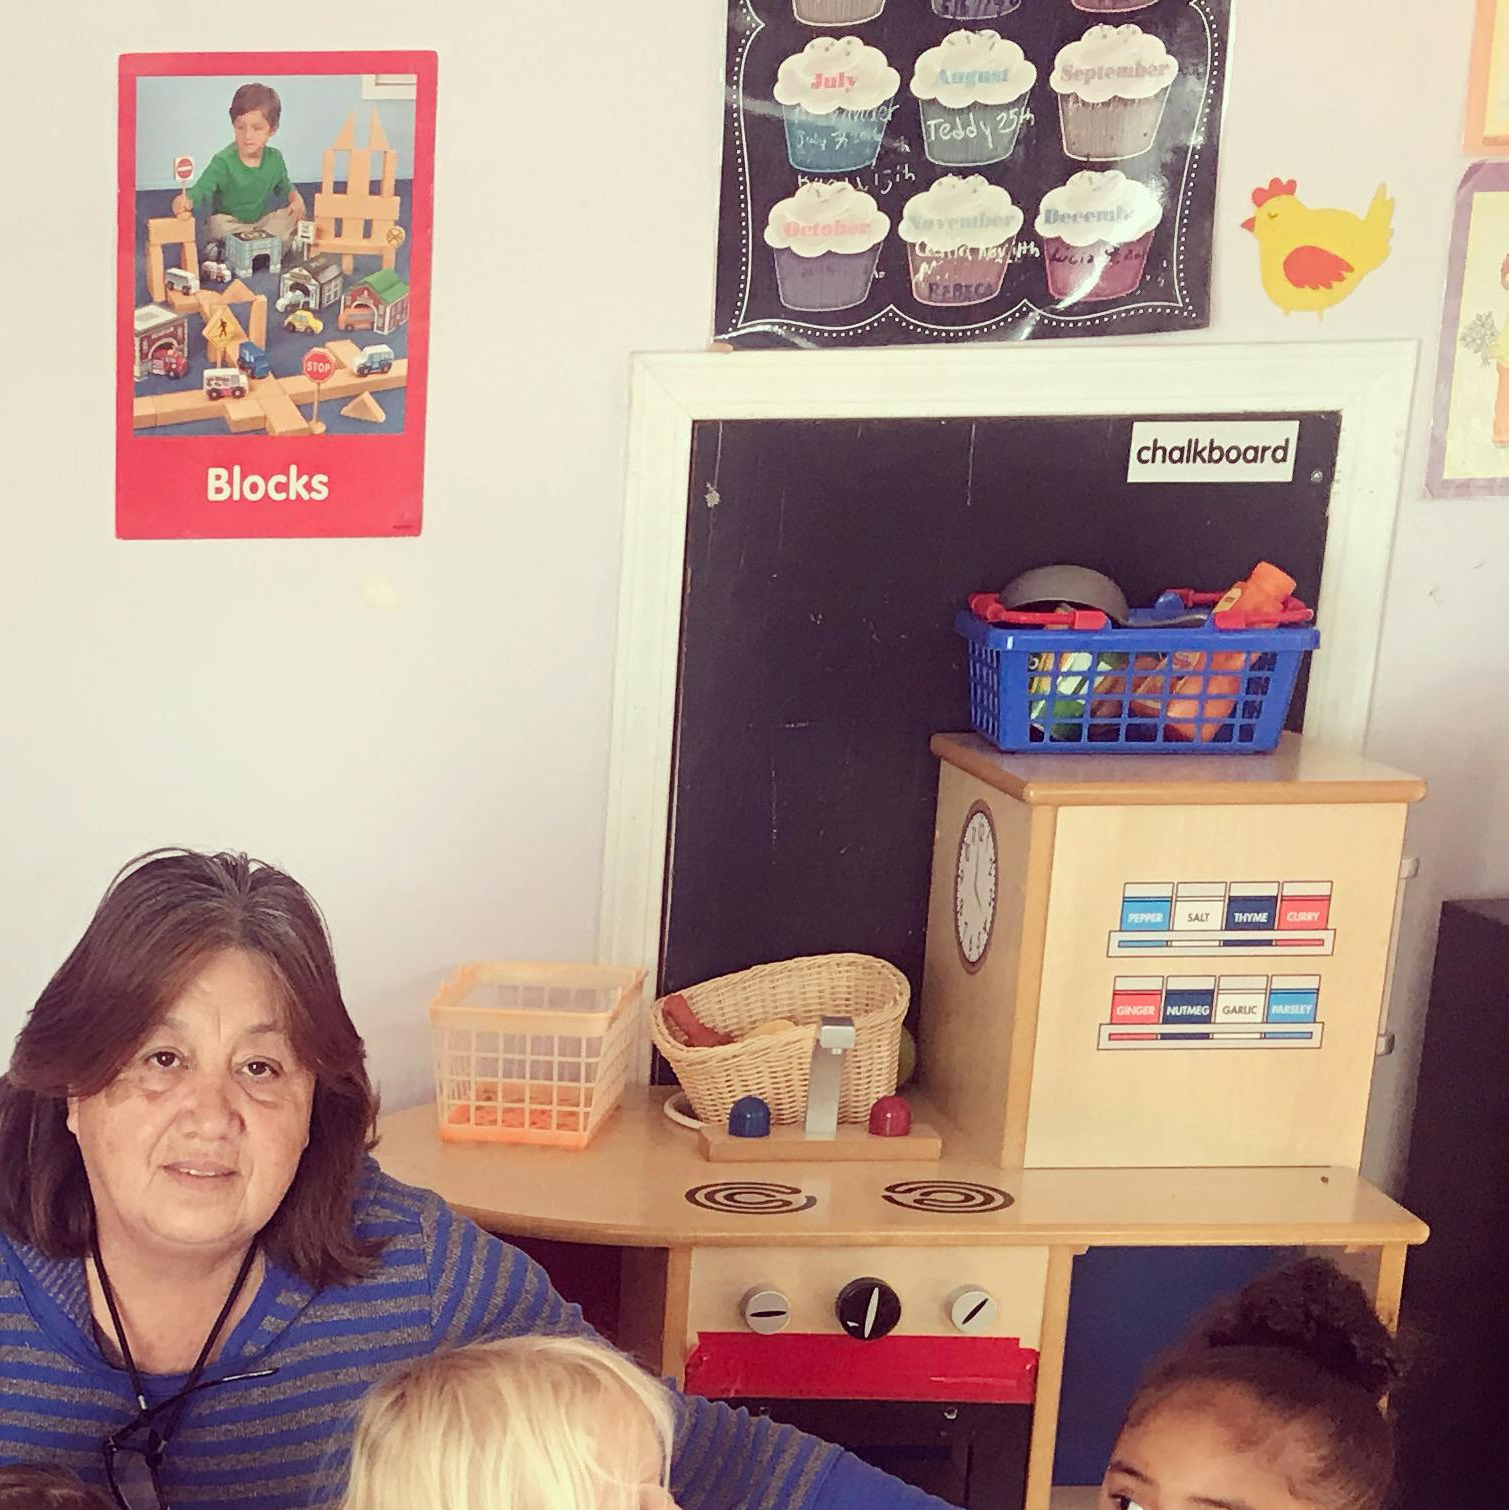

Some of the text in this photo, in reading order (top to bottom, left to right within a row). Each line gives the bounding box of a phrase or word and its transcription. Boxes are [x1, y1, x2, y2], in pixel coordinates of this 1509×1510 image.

[938, 68, 1008, 88] August
[1060, 62, 1170, 85] September
[810, 71, 857, 90] July
[926, 112, 993, 149] Teddy
[910, 210, 1016, 232] November
[783, 218, 870, 239] October
[305, 361, 331, 374] STOP
[1136, 437, 1290, 465] chalkboard
[206, 464, 330, 502] Blocks
[1127, 912, 1164, 923] PEPPER
[1187, 912, 1210, 923] SALT
[1233, 911, 1268, 923] THYME
[1286, 911, 1320, 922] CURRY
[1116, 1005, 1155, 1016] GINGER
[1166, 1005, 1210, 1016] NUTMEG
[1222, 1005, 1258, 1015] GARLIC
[1271, 1004, 1313, 1015] PARSLEY
